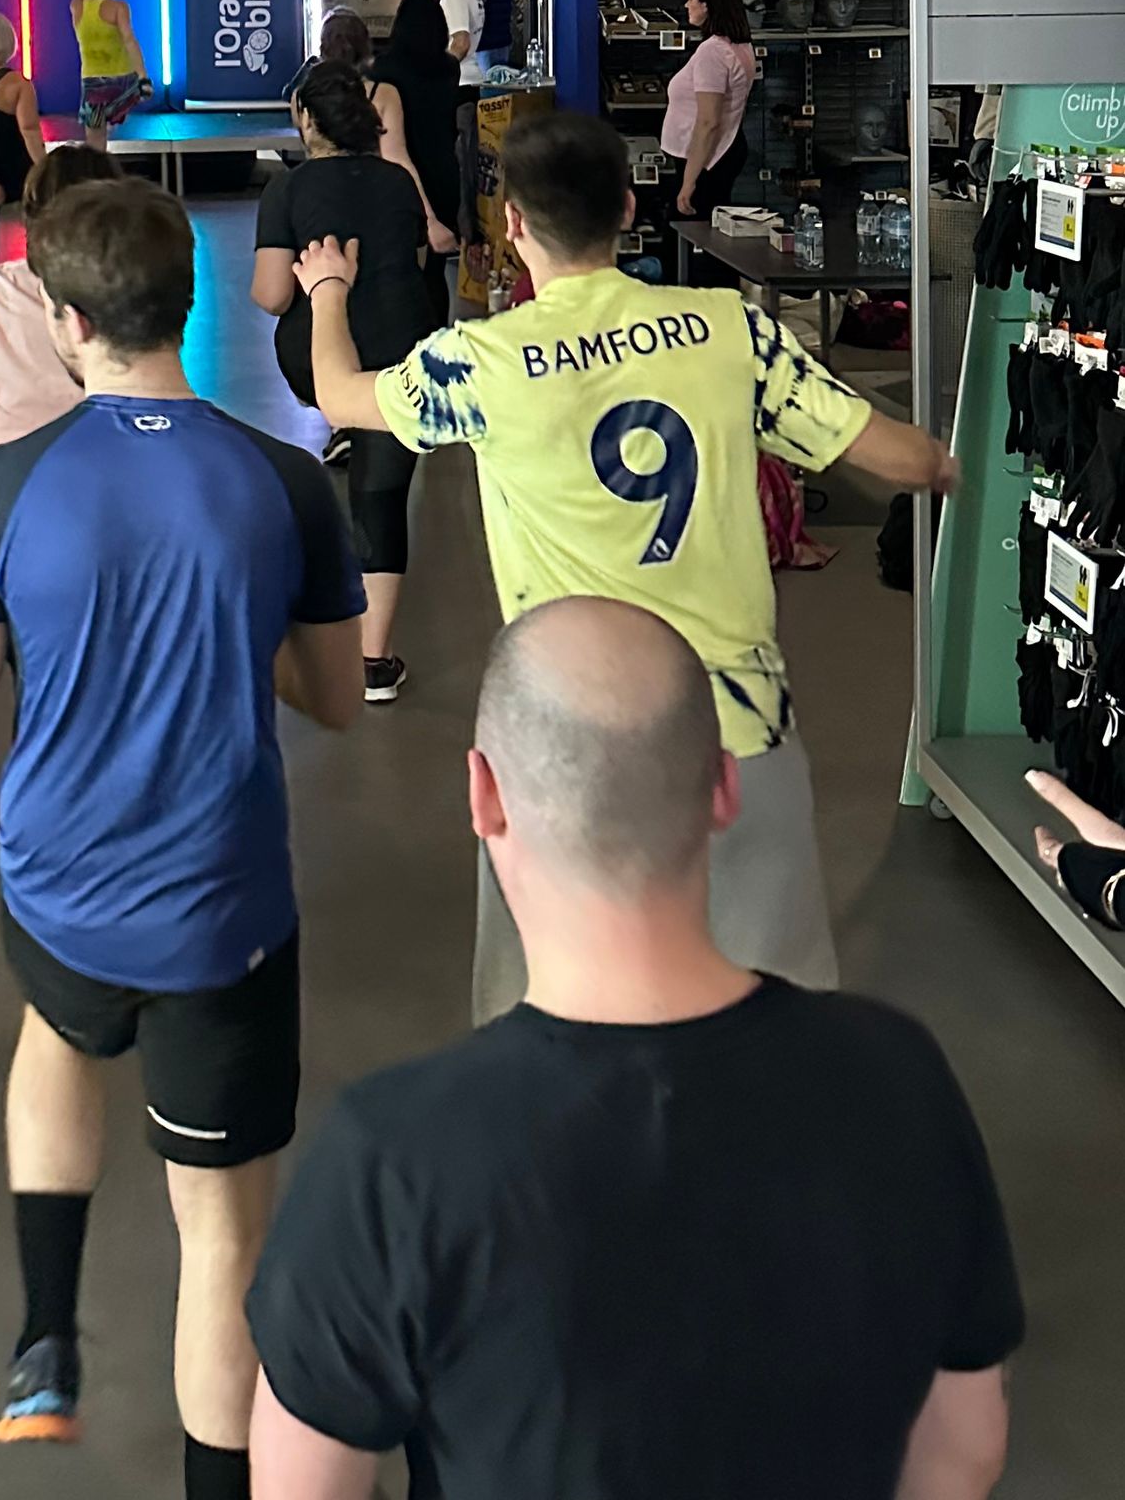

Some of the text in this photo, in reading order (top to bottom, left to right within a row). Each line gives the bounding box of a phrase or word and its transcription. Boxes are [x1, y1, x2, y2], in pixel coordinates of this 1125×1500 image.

[1067, 86, 1121, 113] Climb
[522, 312, 710, 378] BAMFORD
[590, 398, 699, 566] 9
